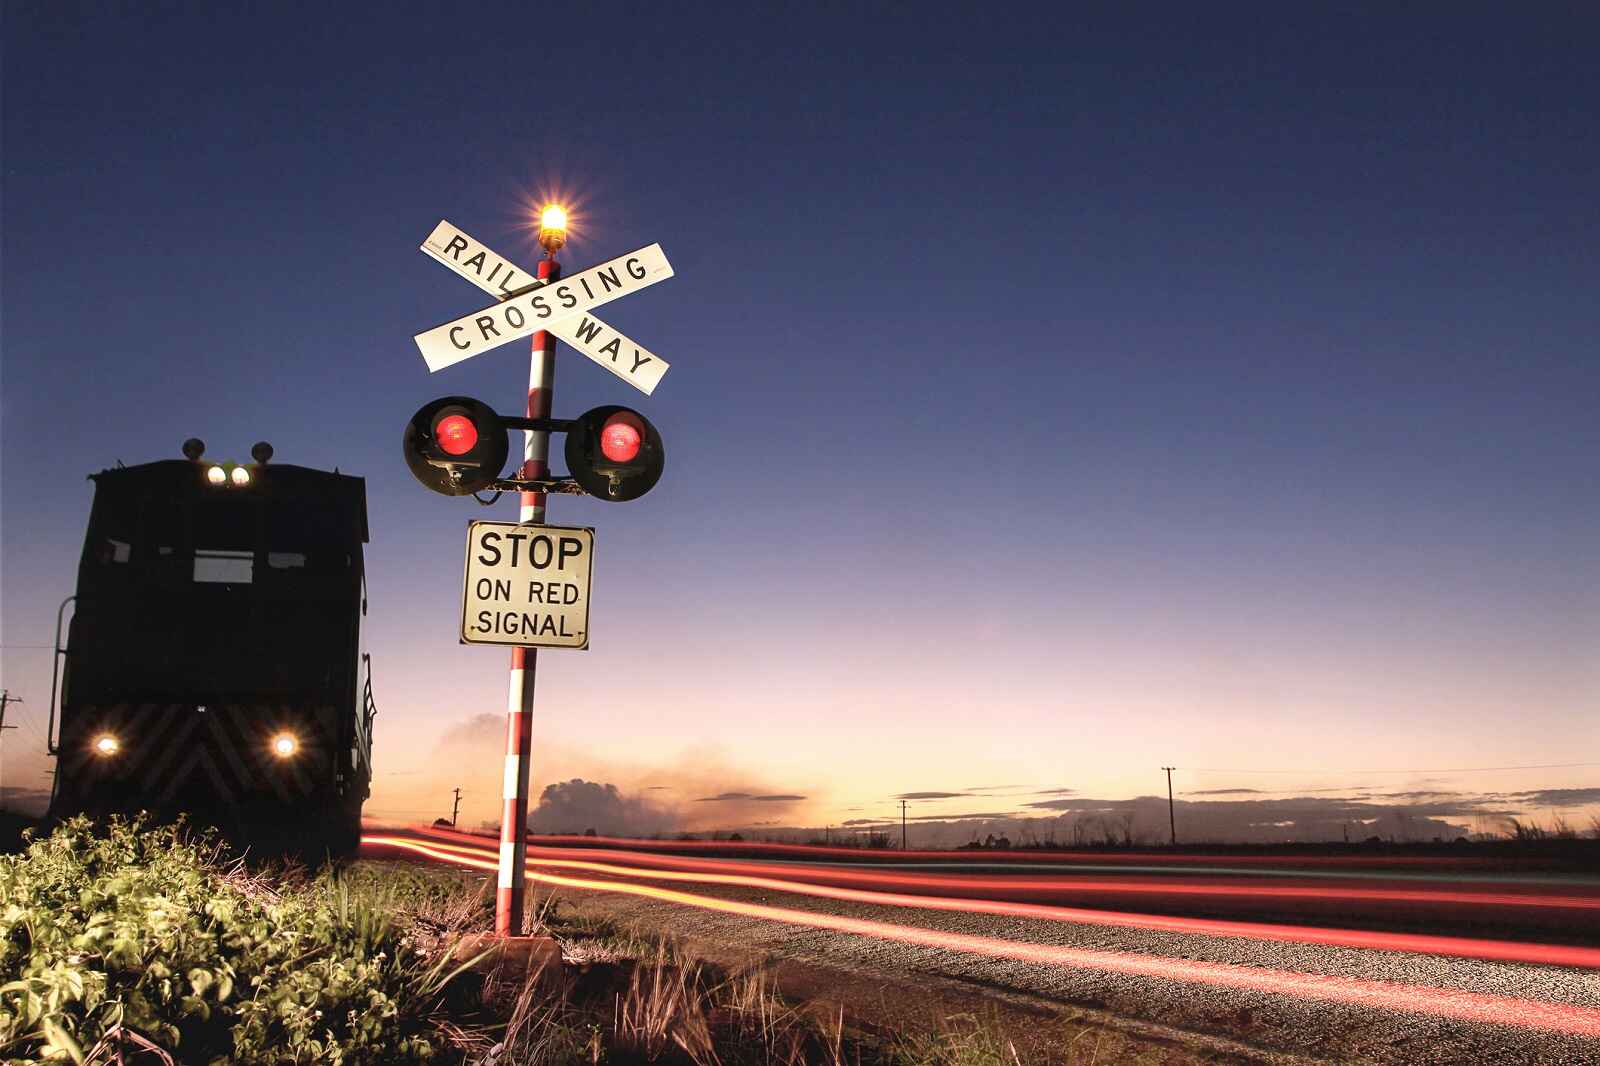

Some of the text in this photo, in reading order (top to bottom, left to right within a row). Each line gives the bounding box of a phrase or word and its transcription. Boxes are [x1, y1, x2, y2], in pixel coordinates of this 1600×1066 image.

[443, 235, 652, 374] RAIL WAY
[449, 258, 647, 350] CROSSING
[478, 532, 583, 570] STOP
[476, 578, 579, 605] ON RED
[477, 610, 574, 637] SIGNAL
